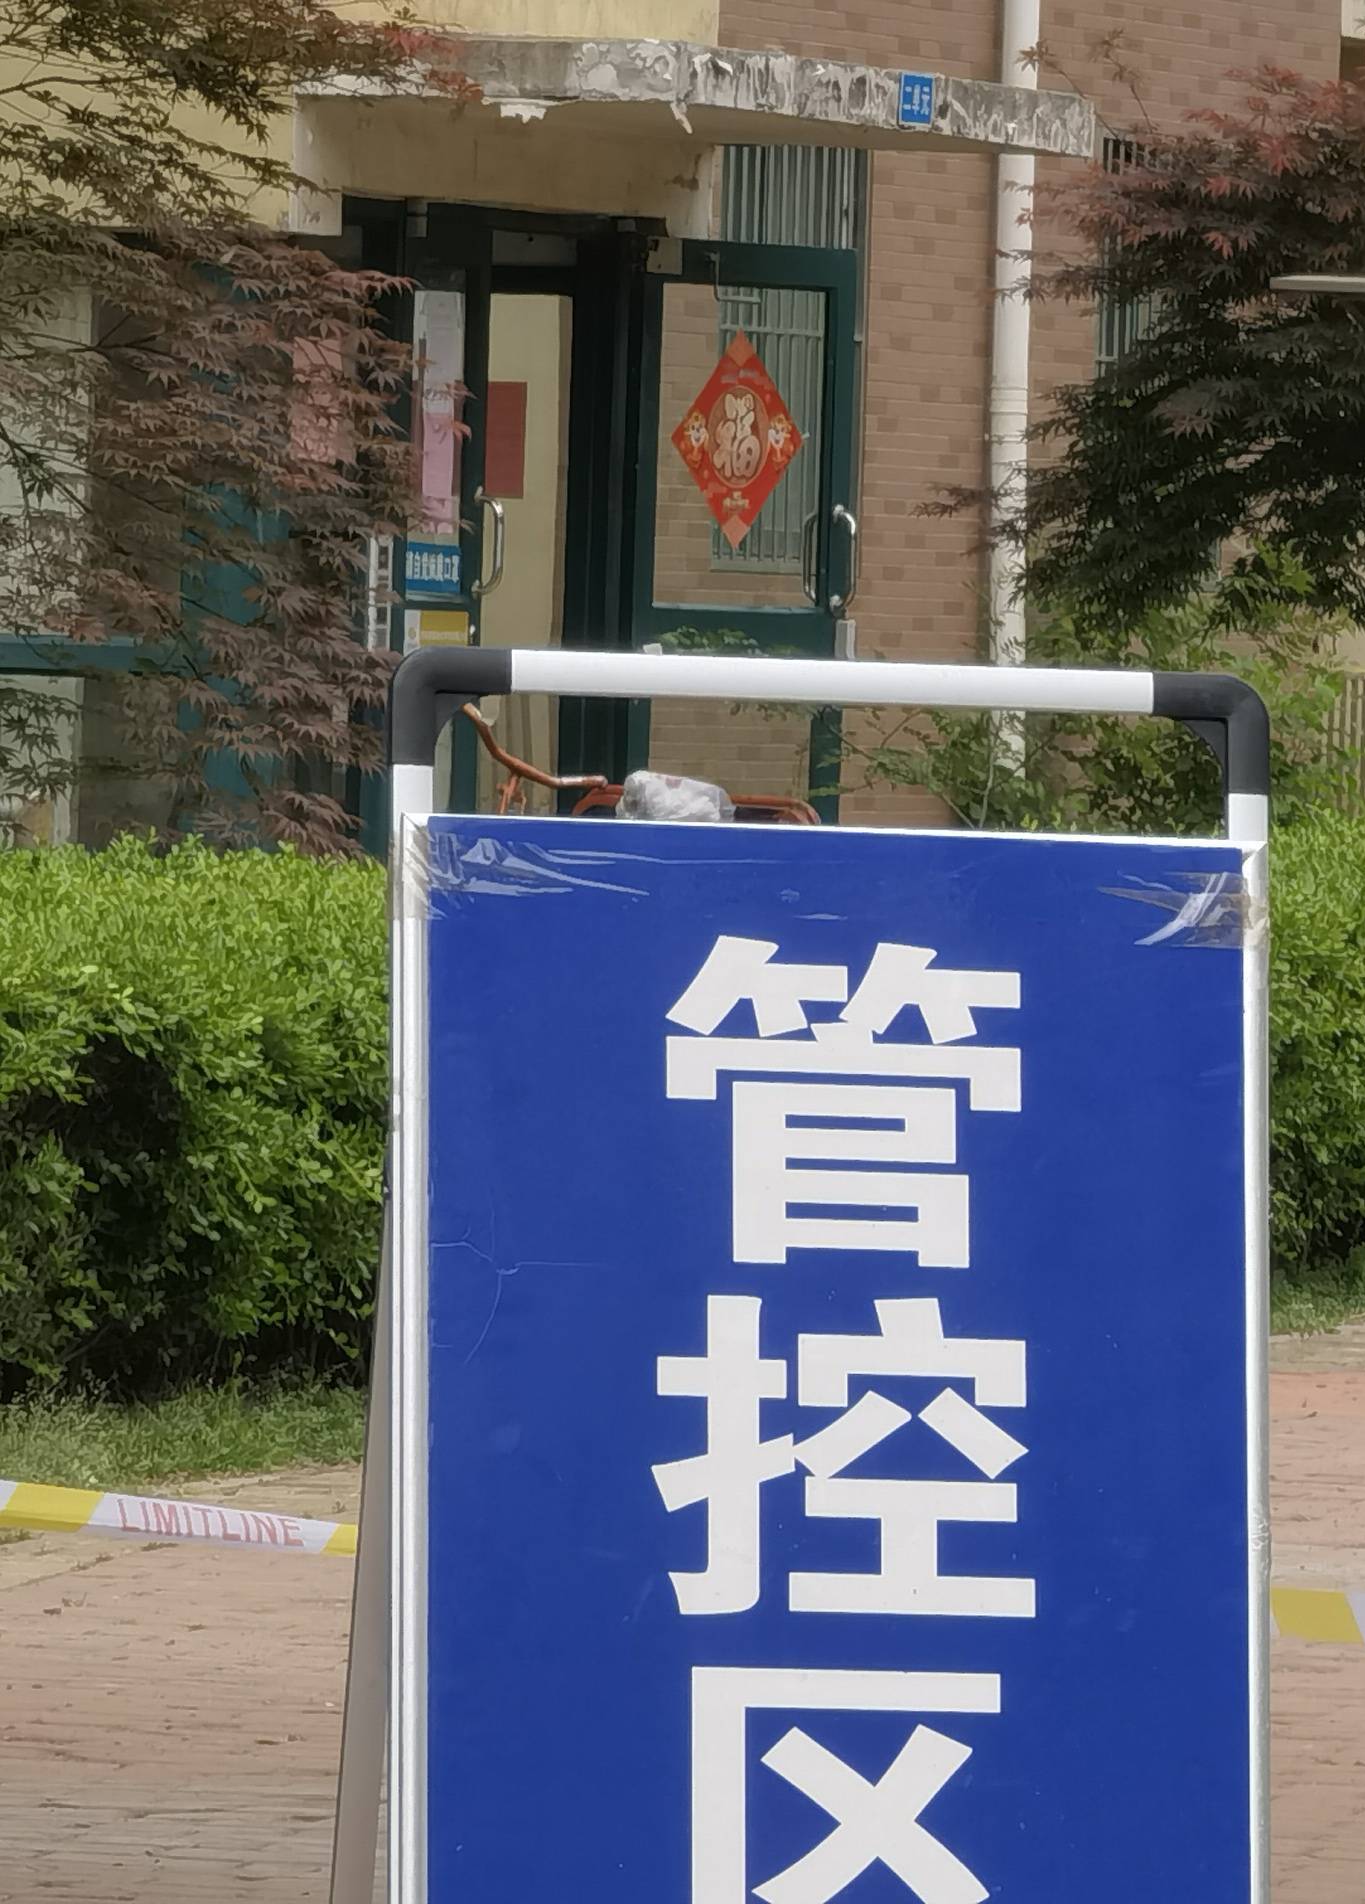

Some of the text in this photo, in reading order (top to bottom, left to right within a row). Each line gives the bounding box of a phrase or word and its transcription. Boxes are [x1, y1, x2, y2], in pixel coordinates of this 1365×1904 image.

[903, 83, 931, 116] 二单元
[650, 934, 1037, 1904] 管控区
[116, 1498, 305, 1547] LIMITLINE
